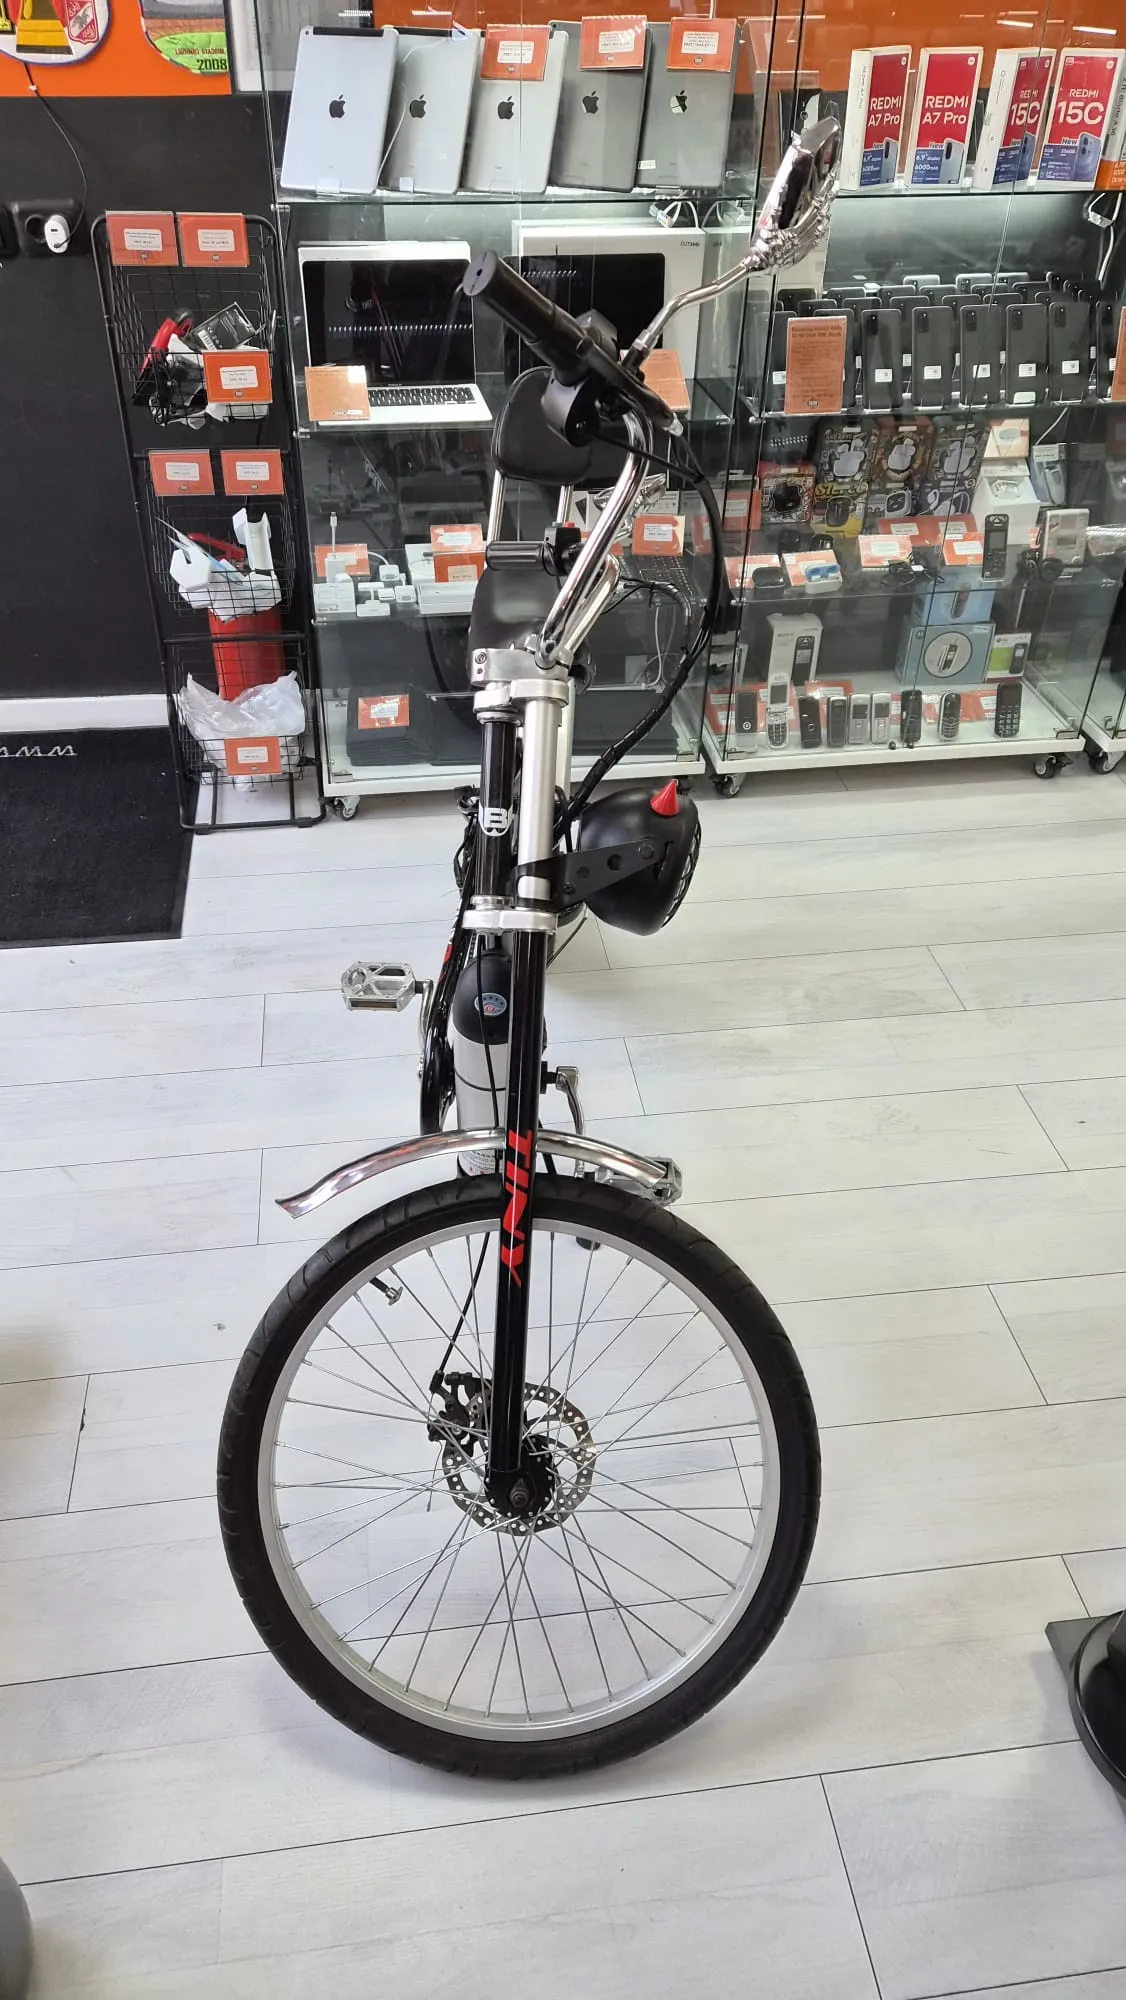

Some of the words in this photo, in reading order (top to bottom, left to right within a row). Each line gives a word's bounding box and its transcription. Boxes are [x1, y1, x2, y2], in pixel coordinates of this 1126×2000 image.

[196, 59, 227, 70] 2008
[1019, 89, 1038, 99] REDMI
[1069, 88, 1099, 99] REDMI
[870, 95, 902, 111] REDMI
[925, 95, 969, 109] REDMI
[868, 114, 883, 127] A7
[883, 112, 900, 125] Pro
[922, 112, 941, 125] A7
[943, 112, 967, 125] Pro
[1011, 101, 1040, 126] 15C
[1057, 101, 1104, 125] 15C
[501, 1128, 533, 1288] TINY
